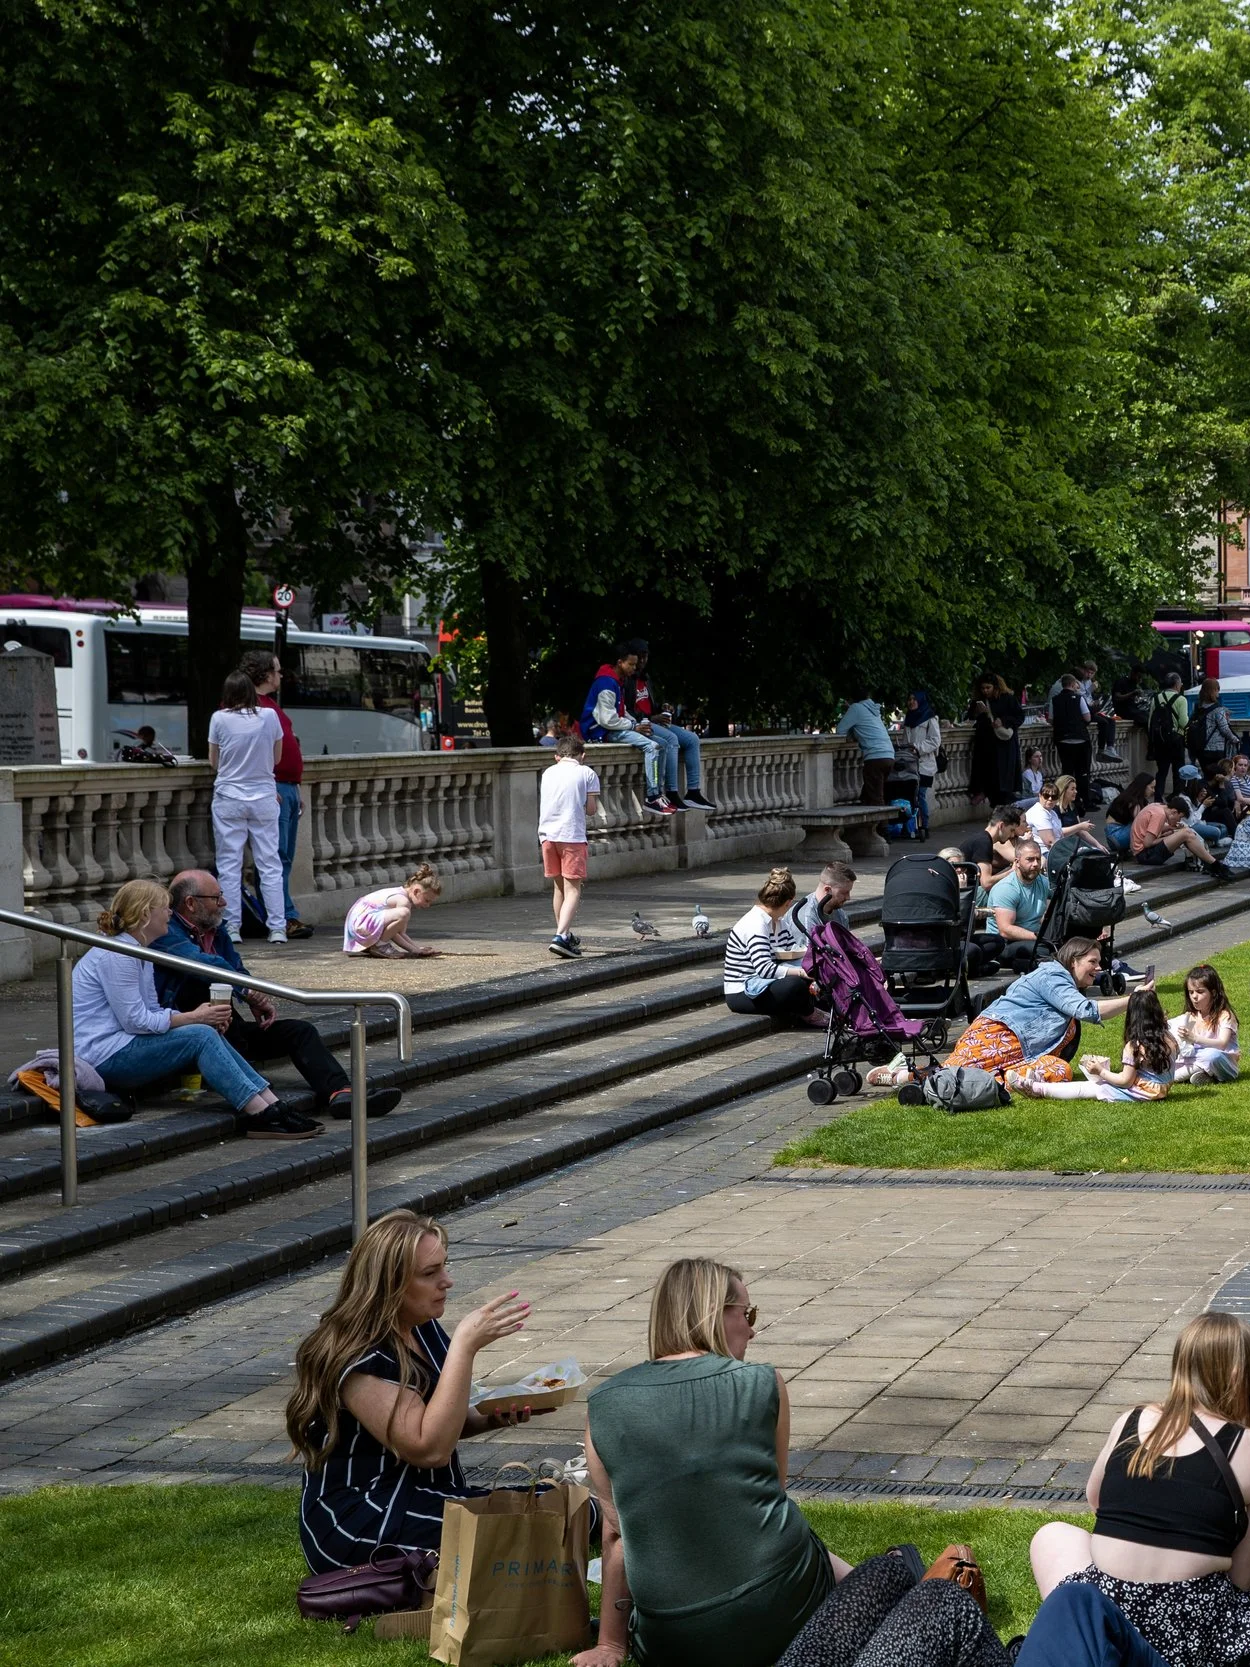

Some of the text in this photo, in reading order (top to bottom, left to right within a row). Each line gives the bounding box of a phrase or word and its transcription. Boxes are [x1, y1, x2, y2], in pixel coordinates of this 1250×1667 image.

[277, 591, 291, 602] 20
[472, 729, 482, 737] Tel
[492, 1556, 575, 1577] PRIMAR
